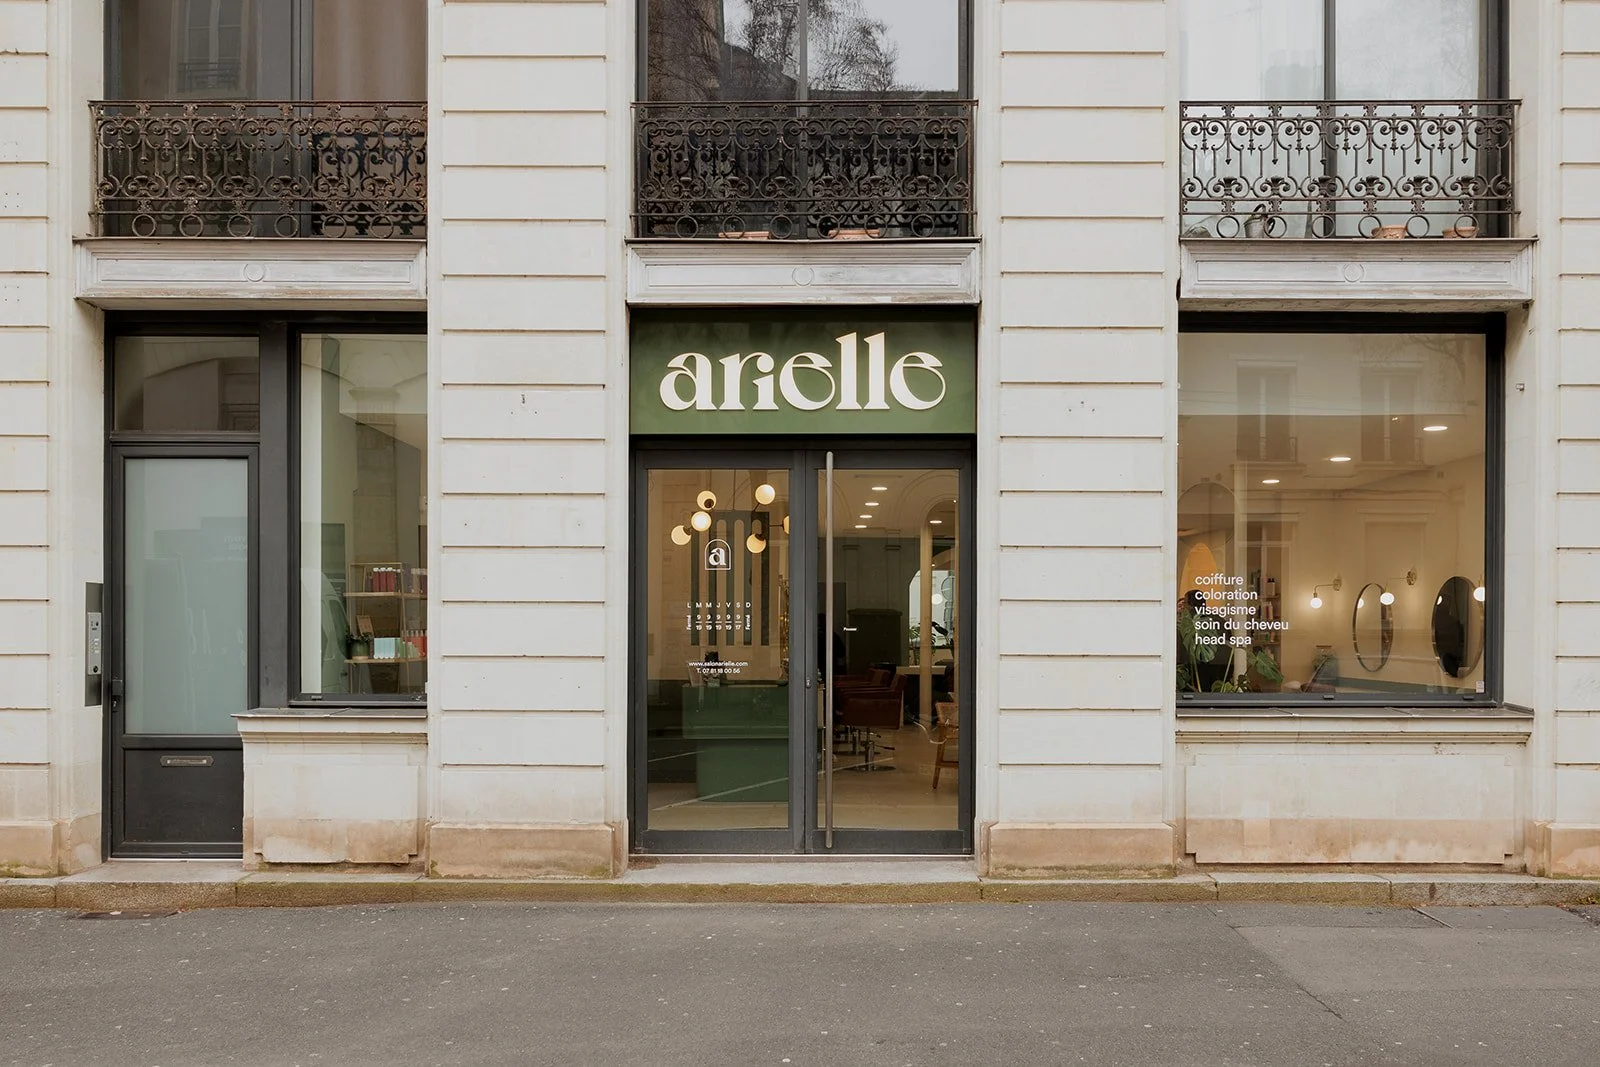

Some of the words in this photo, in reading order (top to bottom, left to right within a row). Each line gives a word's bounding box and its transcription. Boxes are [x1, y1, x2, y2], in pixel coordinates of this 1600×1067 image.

[660, 332, 946, 410] arielle
[709, 548, 726, 566] a
[1194, 573, 1244, 585] coiffure
[1194, 588, 1258, 600] coloration
[1194, 603, 1256, 618] visagisme
[1194, 618, 1220, 630] soin
[1224, 618, 1240, 630] du
[1244, 618, 1289, 630] cheveu
[1195, 633, 1226, 645] head
[1230, 636, 1252, 647] spa
